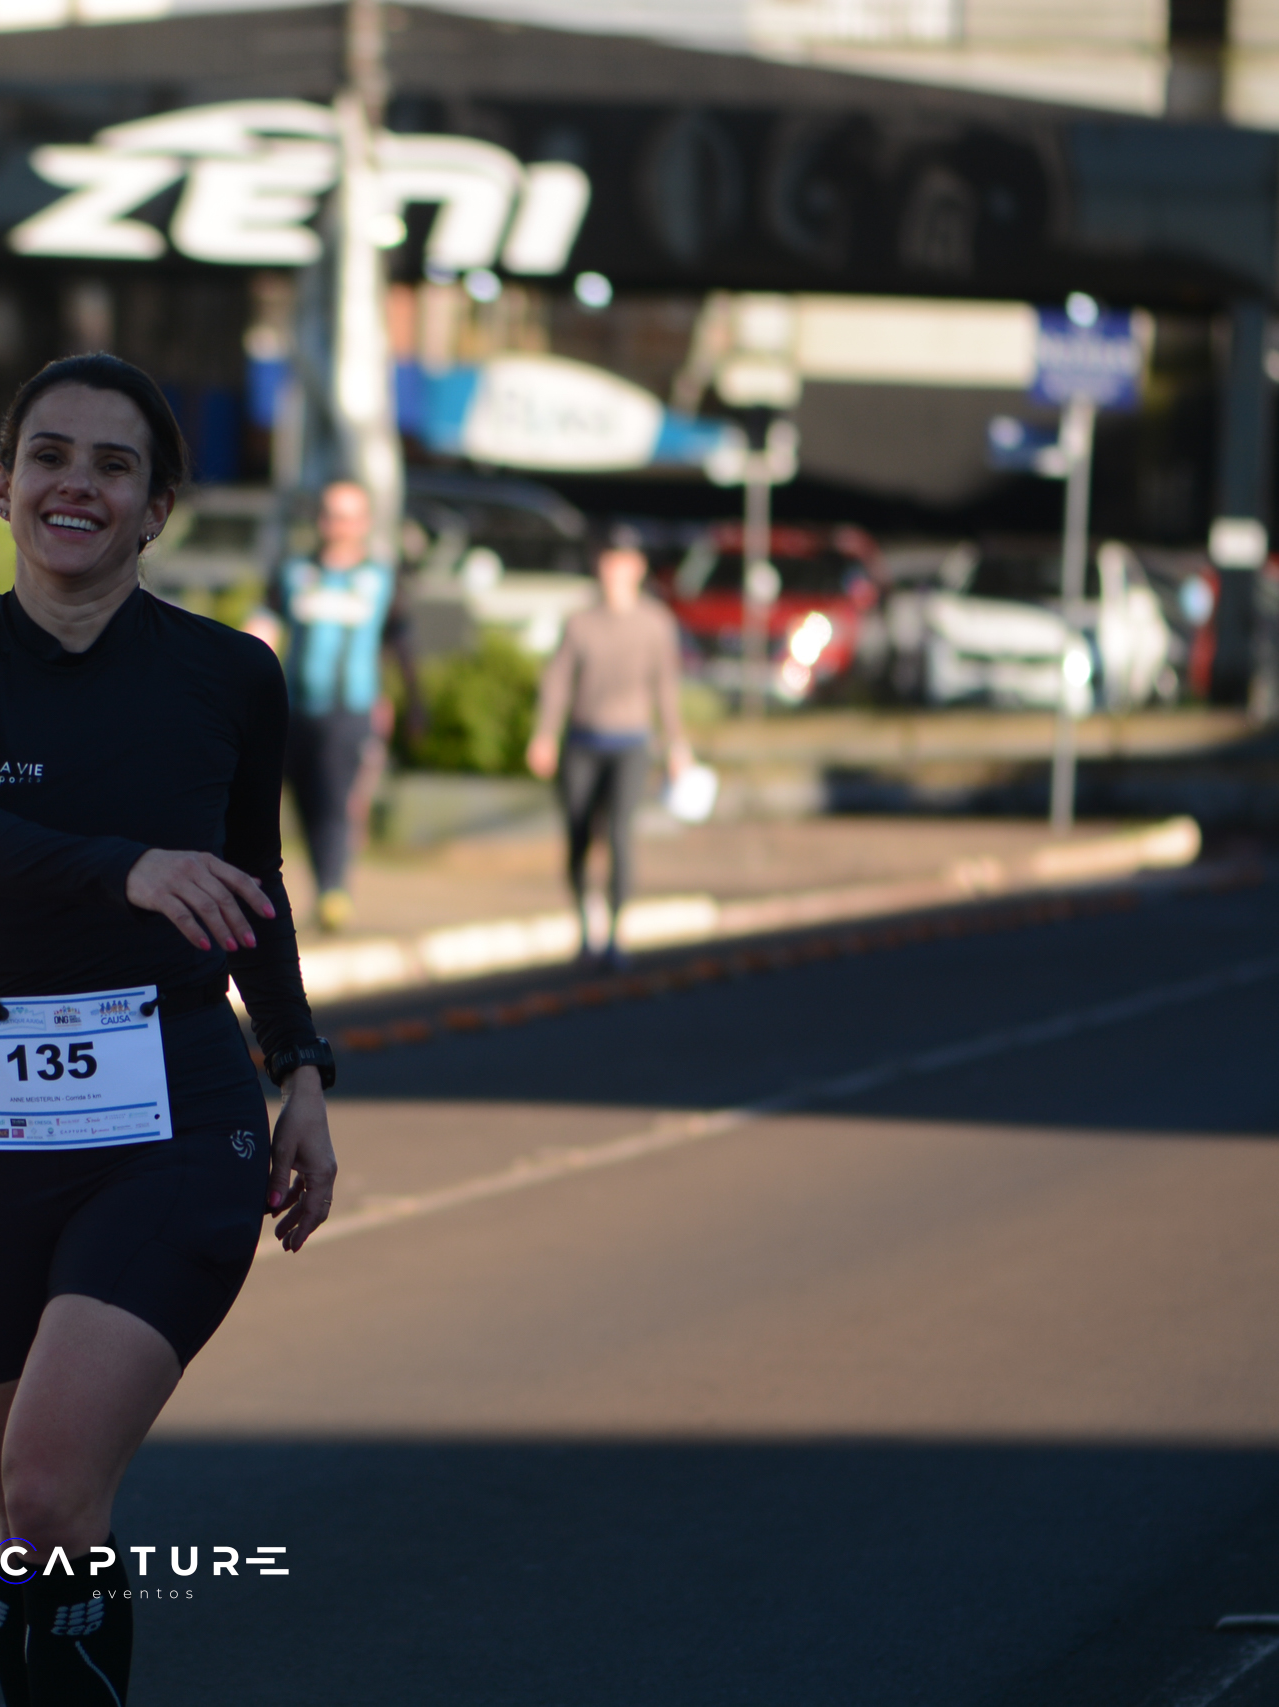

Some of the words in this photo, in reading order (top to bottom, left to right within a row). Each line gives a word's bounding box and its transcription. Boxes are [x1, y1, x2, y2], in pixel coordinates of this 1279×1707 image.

[16, 762, 44, 777] VIE
[100, 1014, 131, 1026] CAUSA
[7, 1041, 98, 1082] 135
